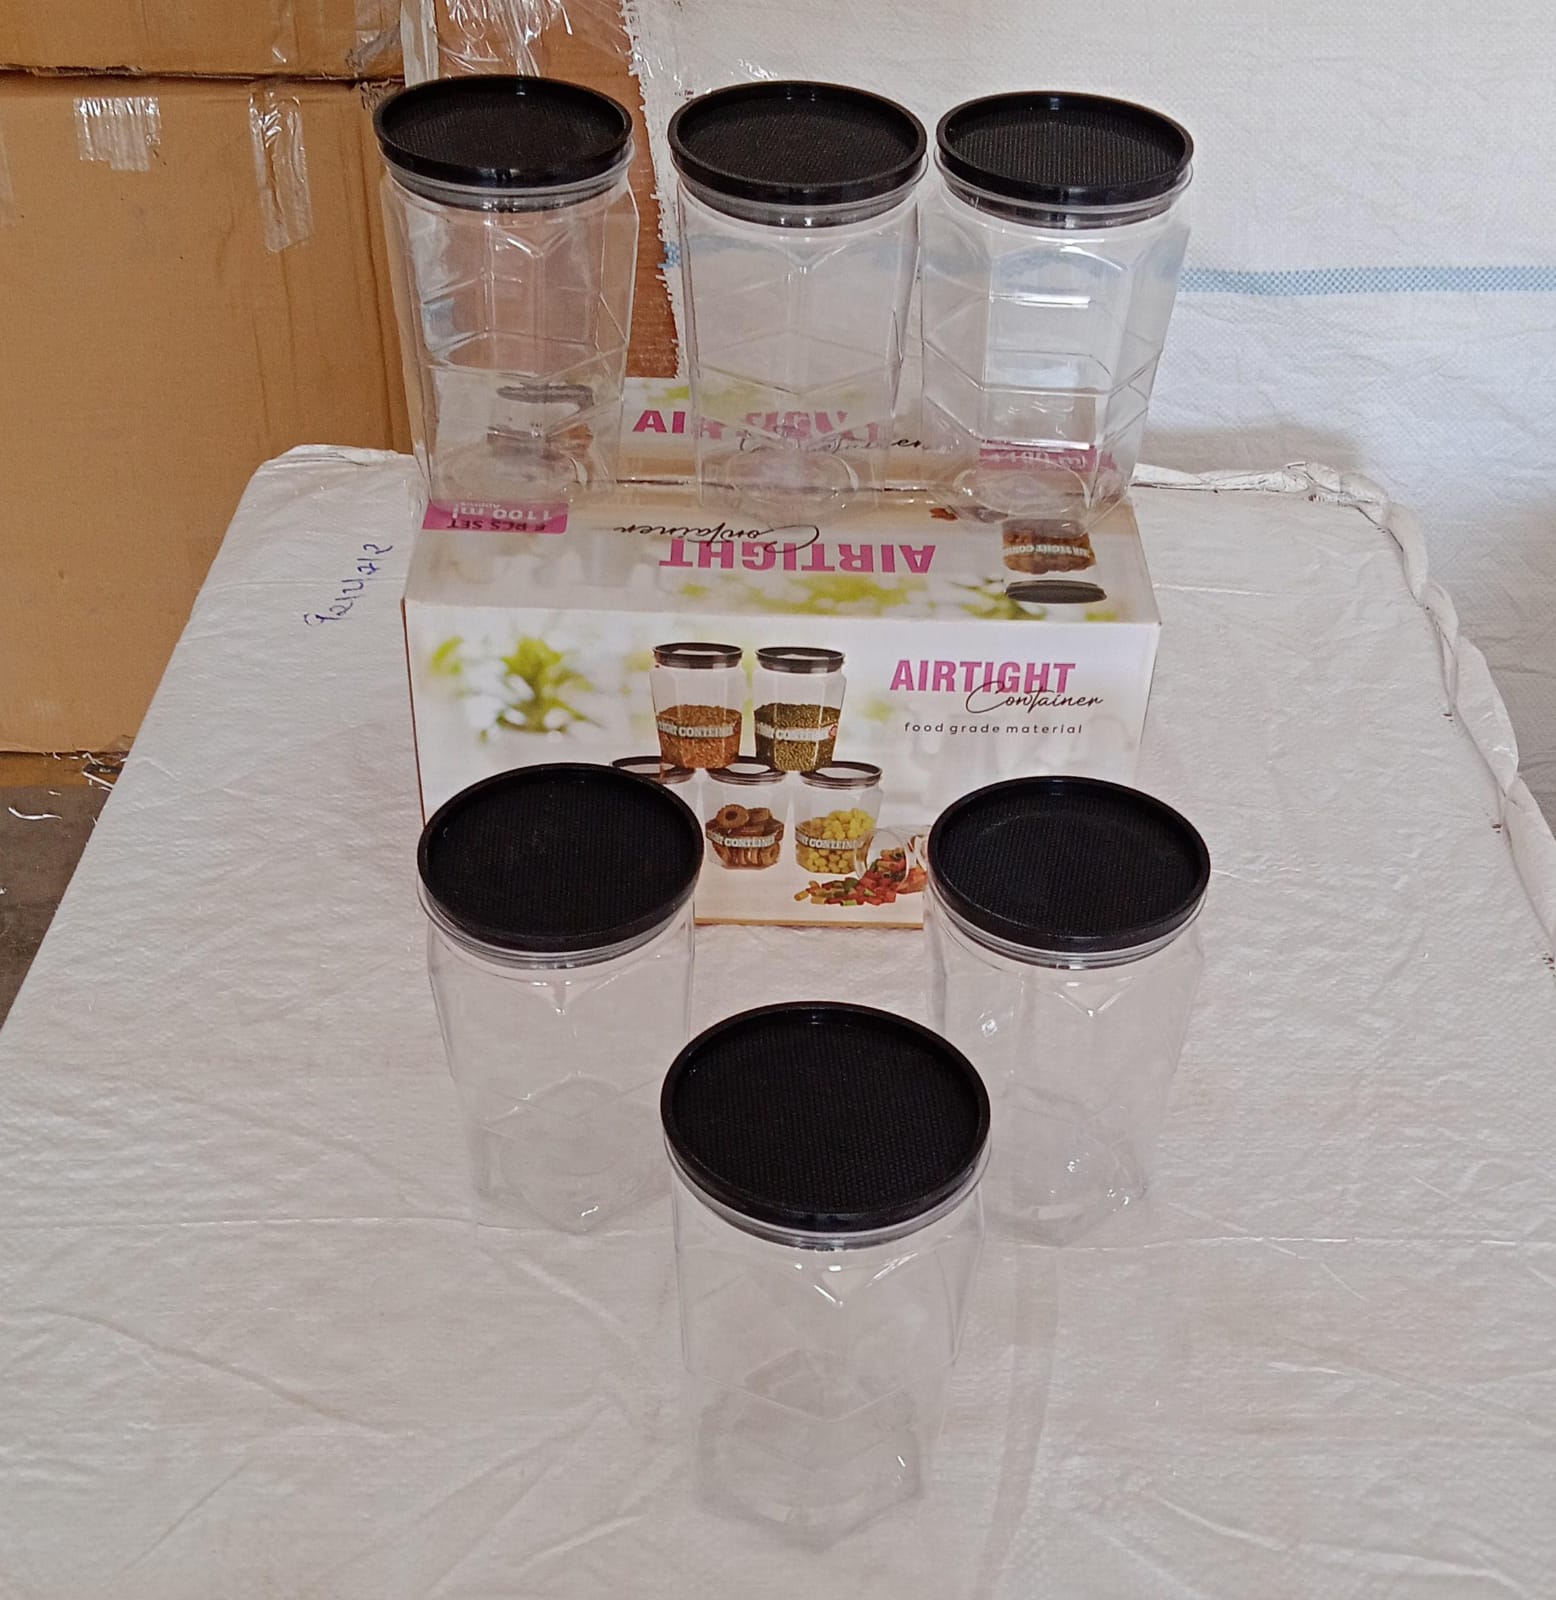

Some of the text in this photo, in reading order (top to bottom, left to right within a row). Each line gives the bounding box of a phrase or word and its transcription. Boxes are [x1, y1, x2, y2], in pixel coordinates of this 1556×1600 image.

[446, 519, 483, 529] SET
[613, 522, 820, 554] Container
[659, 538, 936, 574] AIRTIGHT
[889, 659, 1076, 694] AIRTIGHT
[965, 680, 1104, 714] Container
[904, 722, 1083, 735] food grade material
